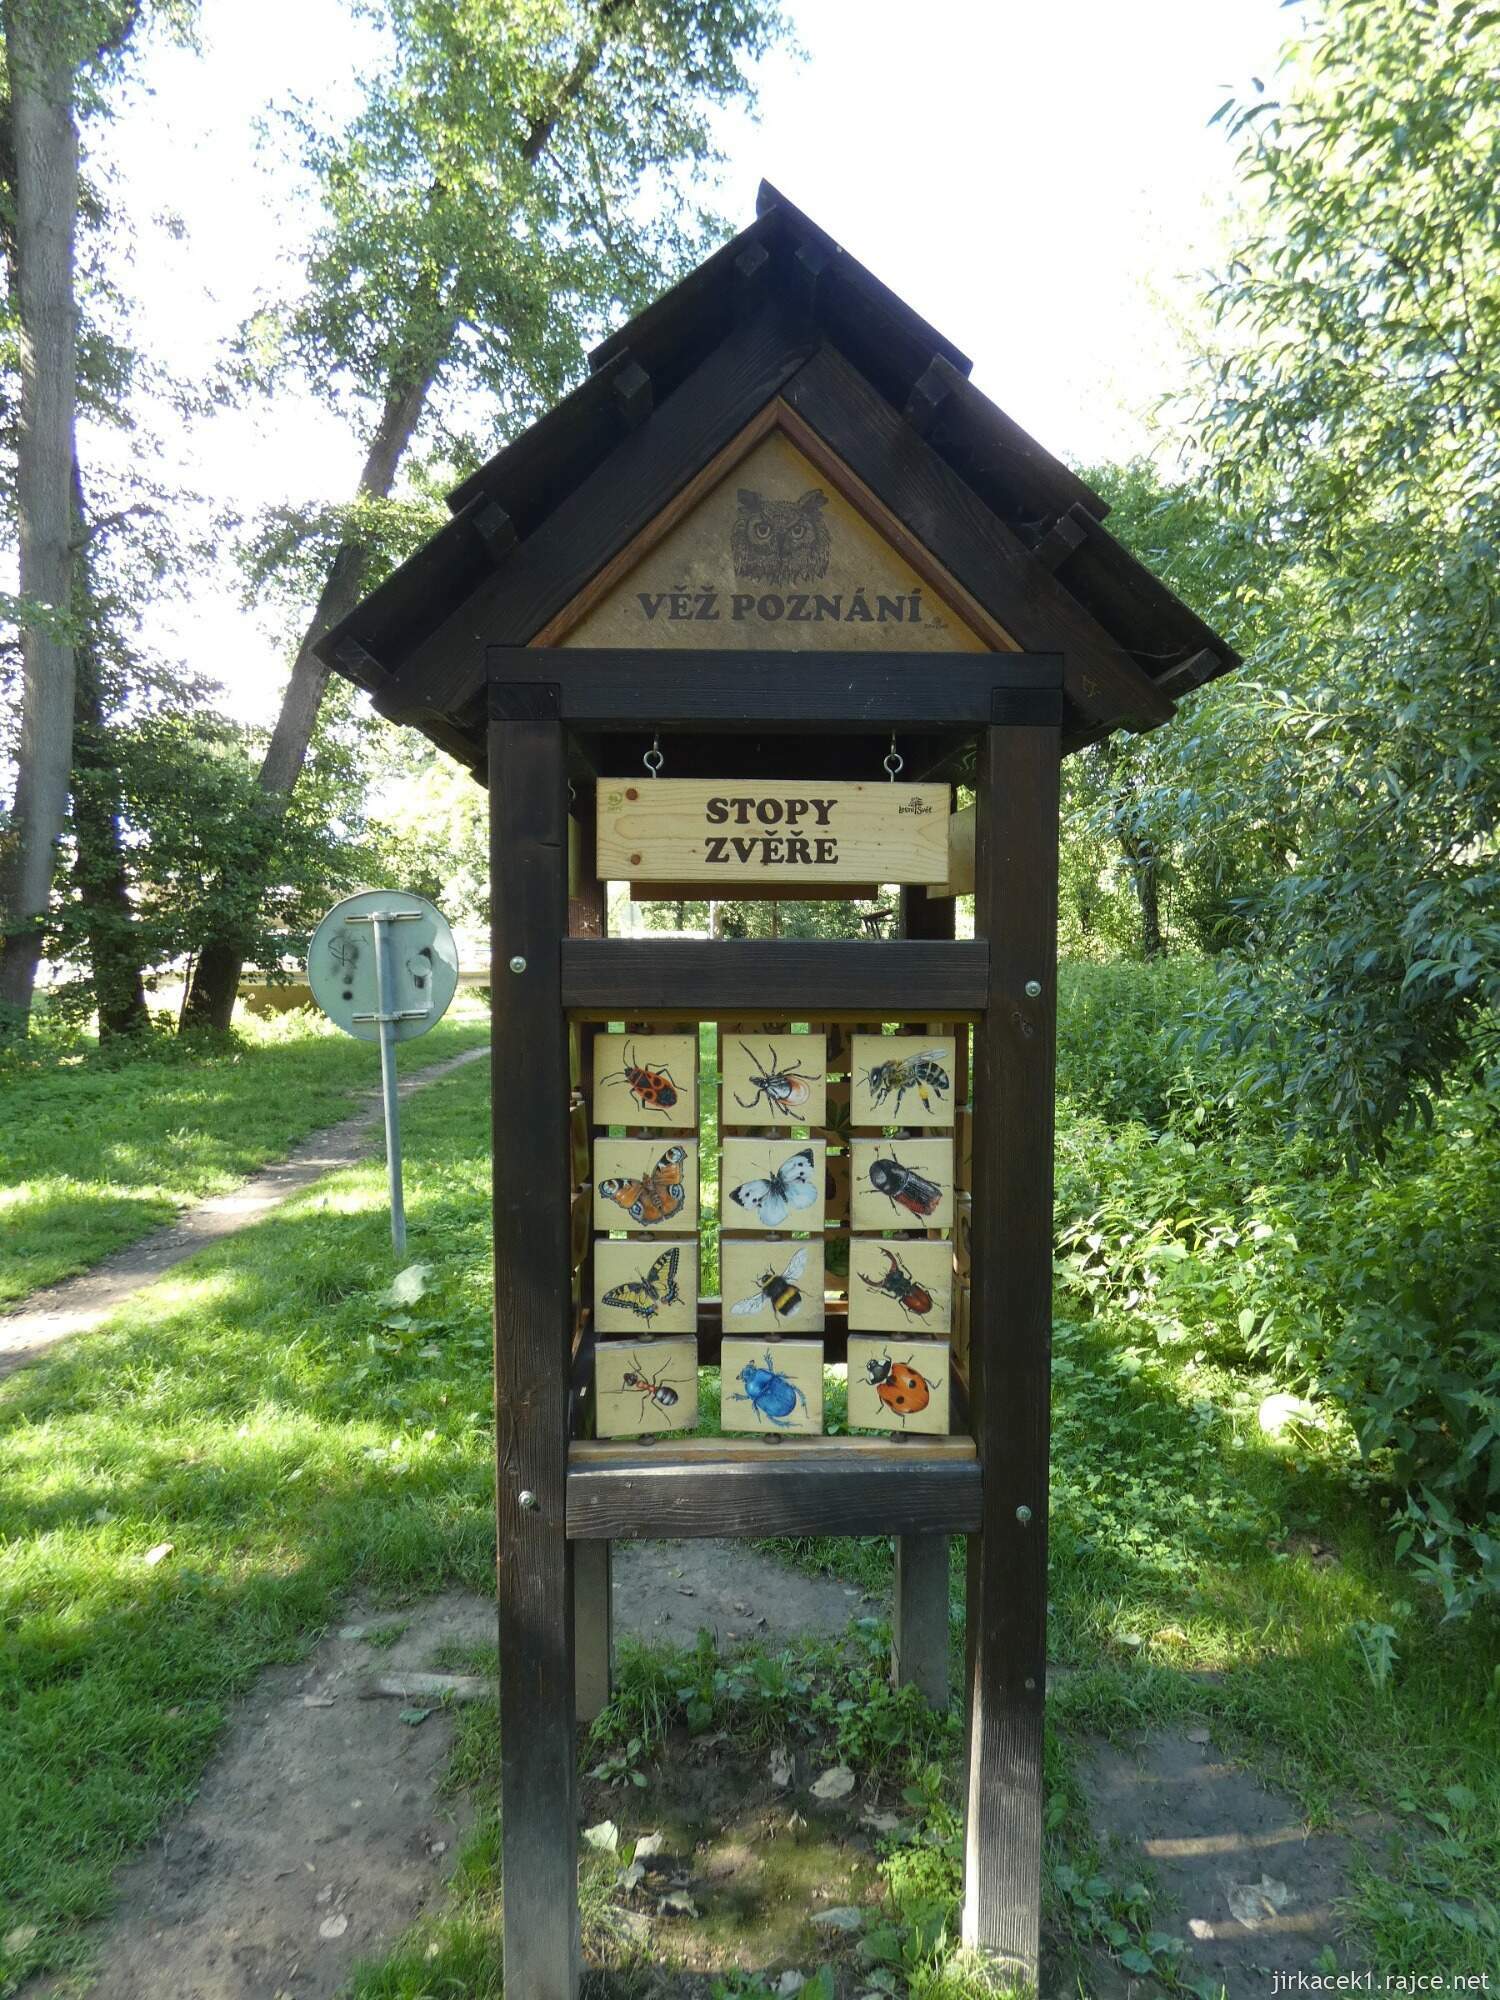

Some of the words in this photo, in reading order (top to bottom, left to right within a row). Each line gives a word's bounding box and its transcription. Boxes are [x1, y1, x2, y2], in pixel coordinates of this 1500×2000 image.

[637, 585, 720, 620] VĚŽ
[730, 587, 922, 622] POZNÁNÍ
[706, 798, 838, 825] STOPY
[705, 830, 839, 864] ZVĚŘE
